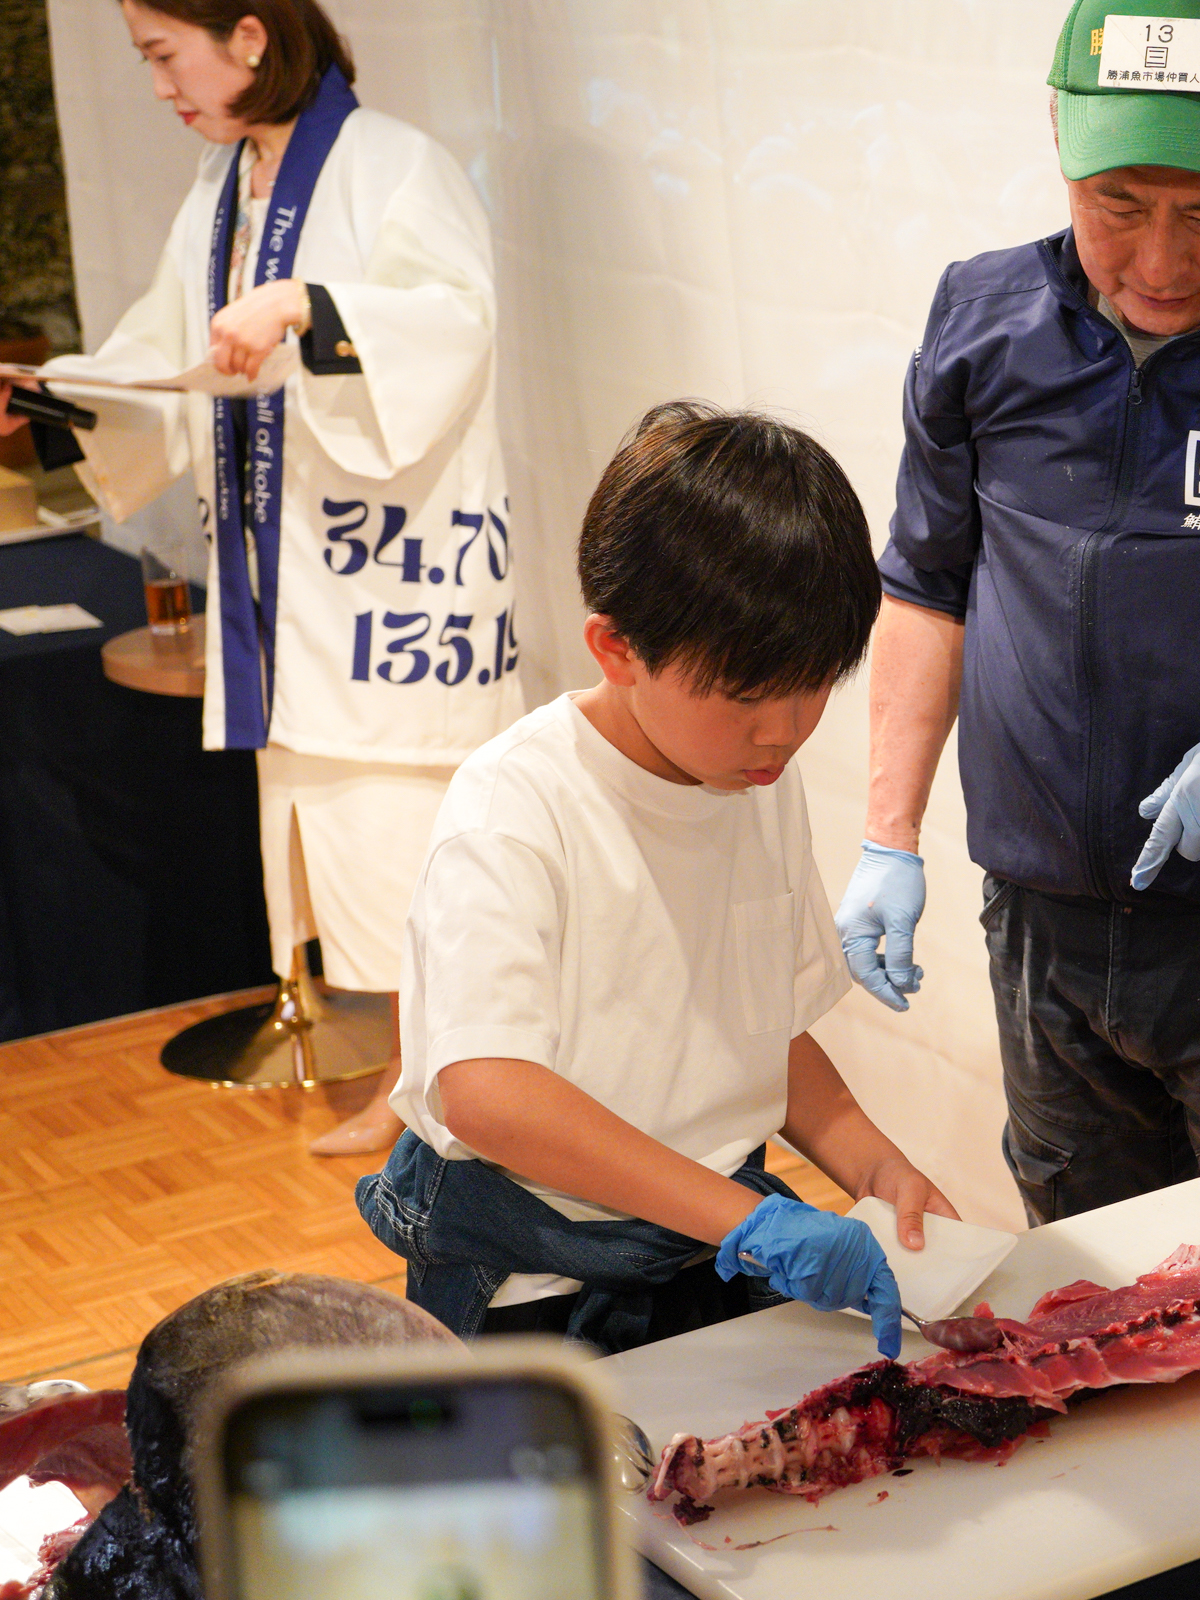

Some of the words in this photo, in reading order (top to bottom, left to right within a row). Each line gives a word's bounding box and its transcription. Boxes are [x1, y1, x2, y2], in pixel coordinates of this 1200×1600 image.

[1145, 24, 1174, 43] 13
[1106, 69, 1200, 83] 勝浦魚市場仲買人
[269, 205, 297, 252] The
[255, 428, 274, 459] of
[254, 460, 273, 523] kobe
[322, 496, 509, 586] 34.70
